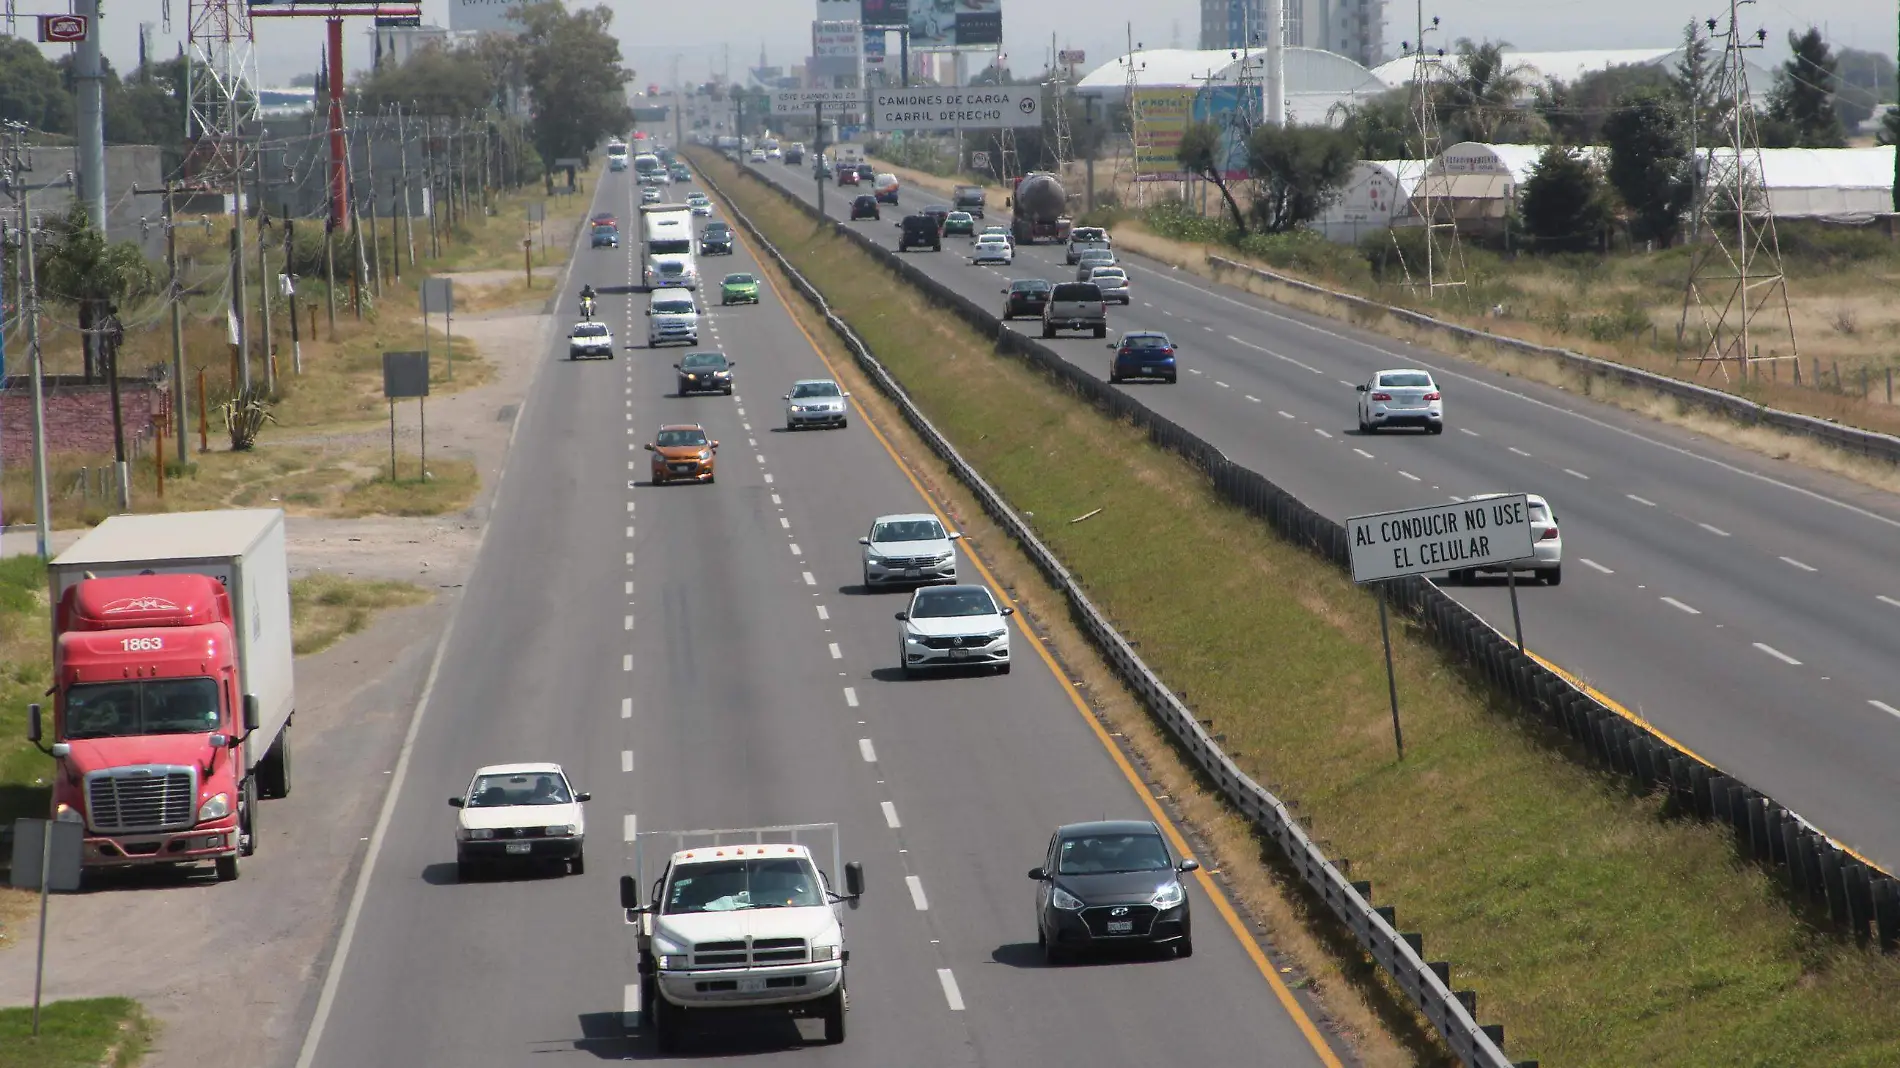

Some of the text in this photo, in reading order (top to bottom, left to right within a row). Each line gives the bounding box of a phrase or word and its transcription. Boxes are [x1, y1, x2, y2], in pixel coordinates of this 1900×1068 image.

[878, 94, 1010, 106] CAMIONES DE CARGA
[886, 110, 1001, 122] CARRIL DERECHO
[1356, 502, 1524, 547] AL CONDUCIR NO USE
[1393, 536, 1490, 569] EL CELULAR
[120, 637, 162, 651] 1863
